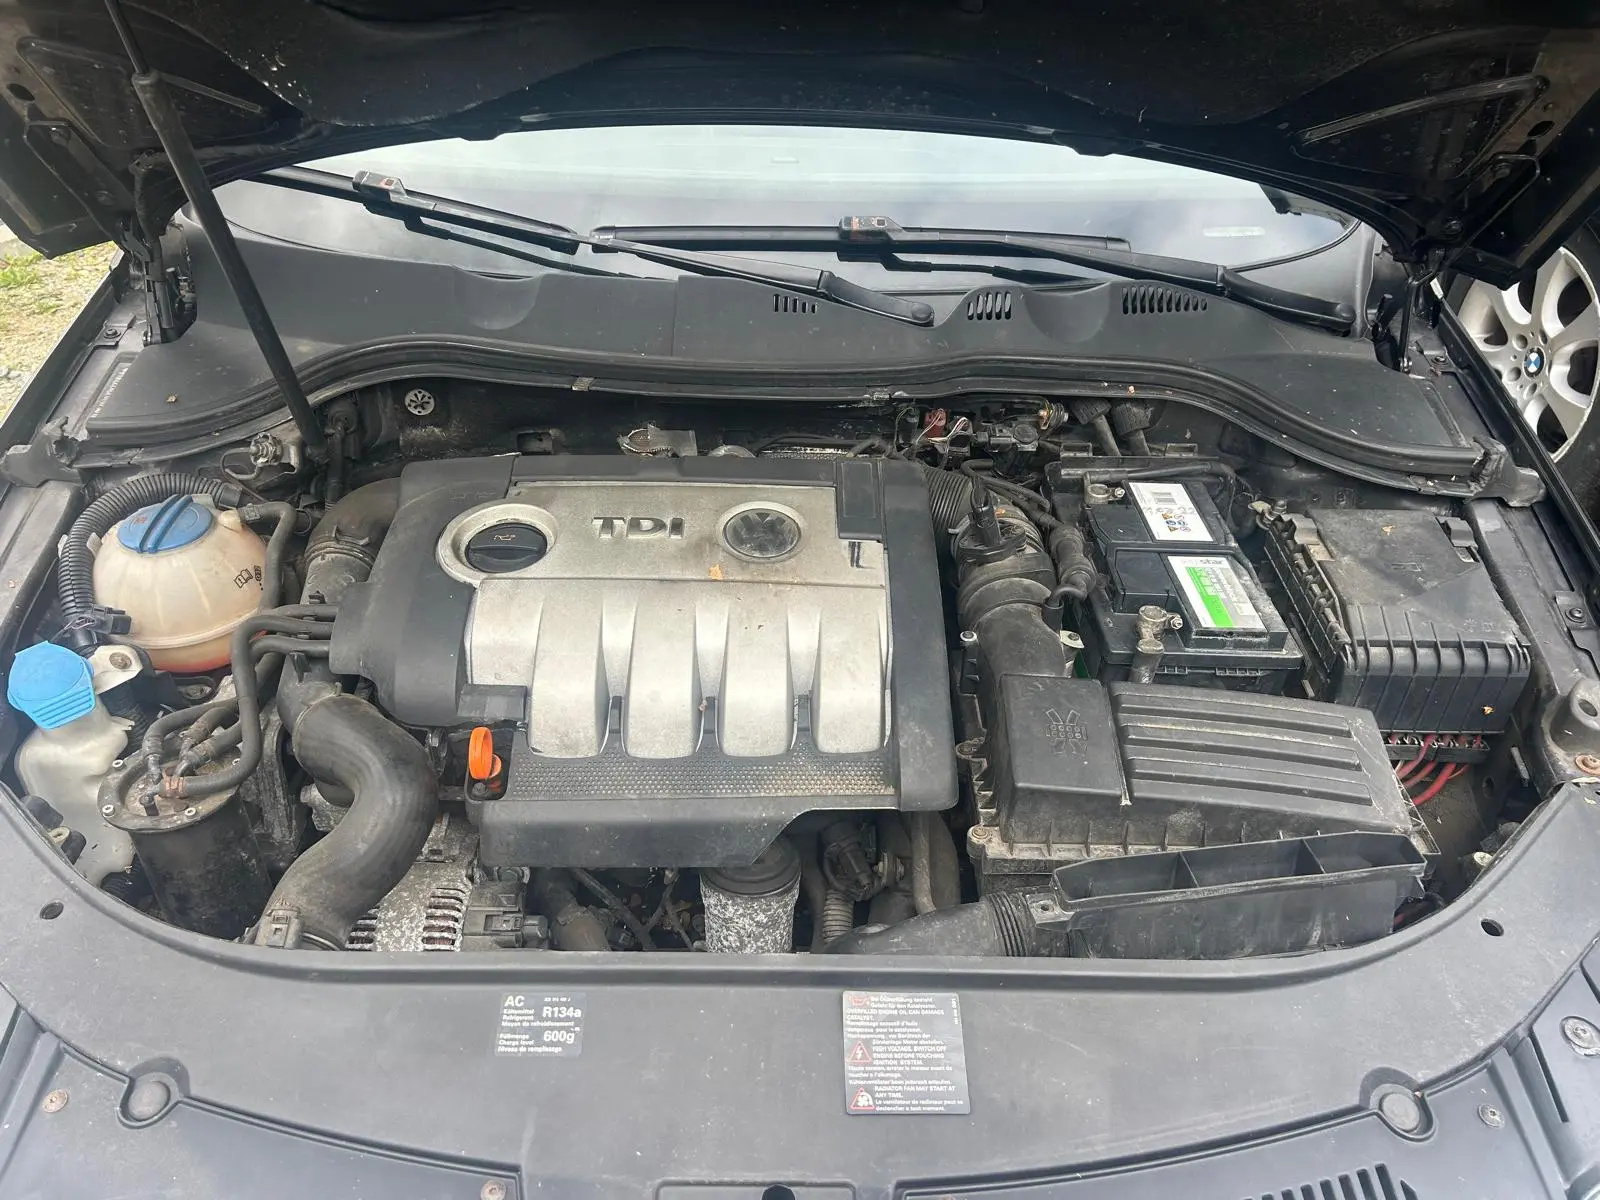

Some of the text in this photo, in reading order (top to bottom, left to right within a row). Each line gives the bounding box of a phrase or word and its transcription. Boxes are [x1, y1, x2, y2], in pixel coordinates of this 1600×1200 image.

[592, 516, 684, 538] TDI
[504, 996, 525, 1007] AC
[542, 1006, 582, 1018] R134a
[544, 1031, 575, 1044] 600g
